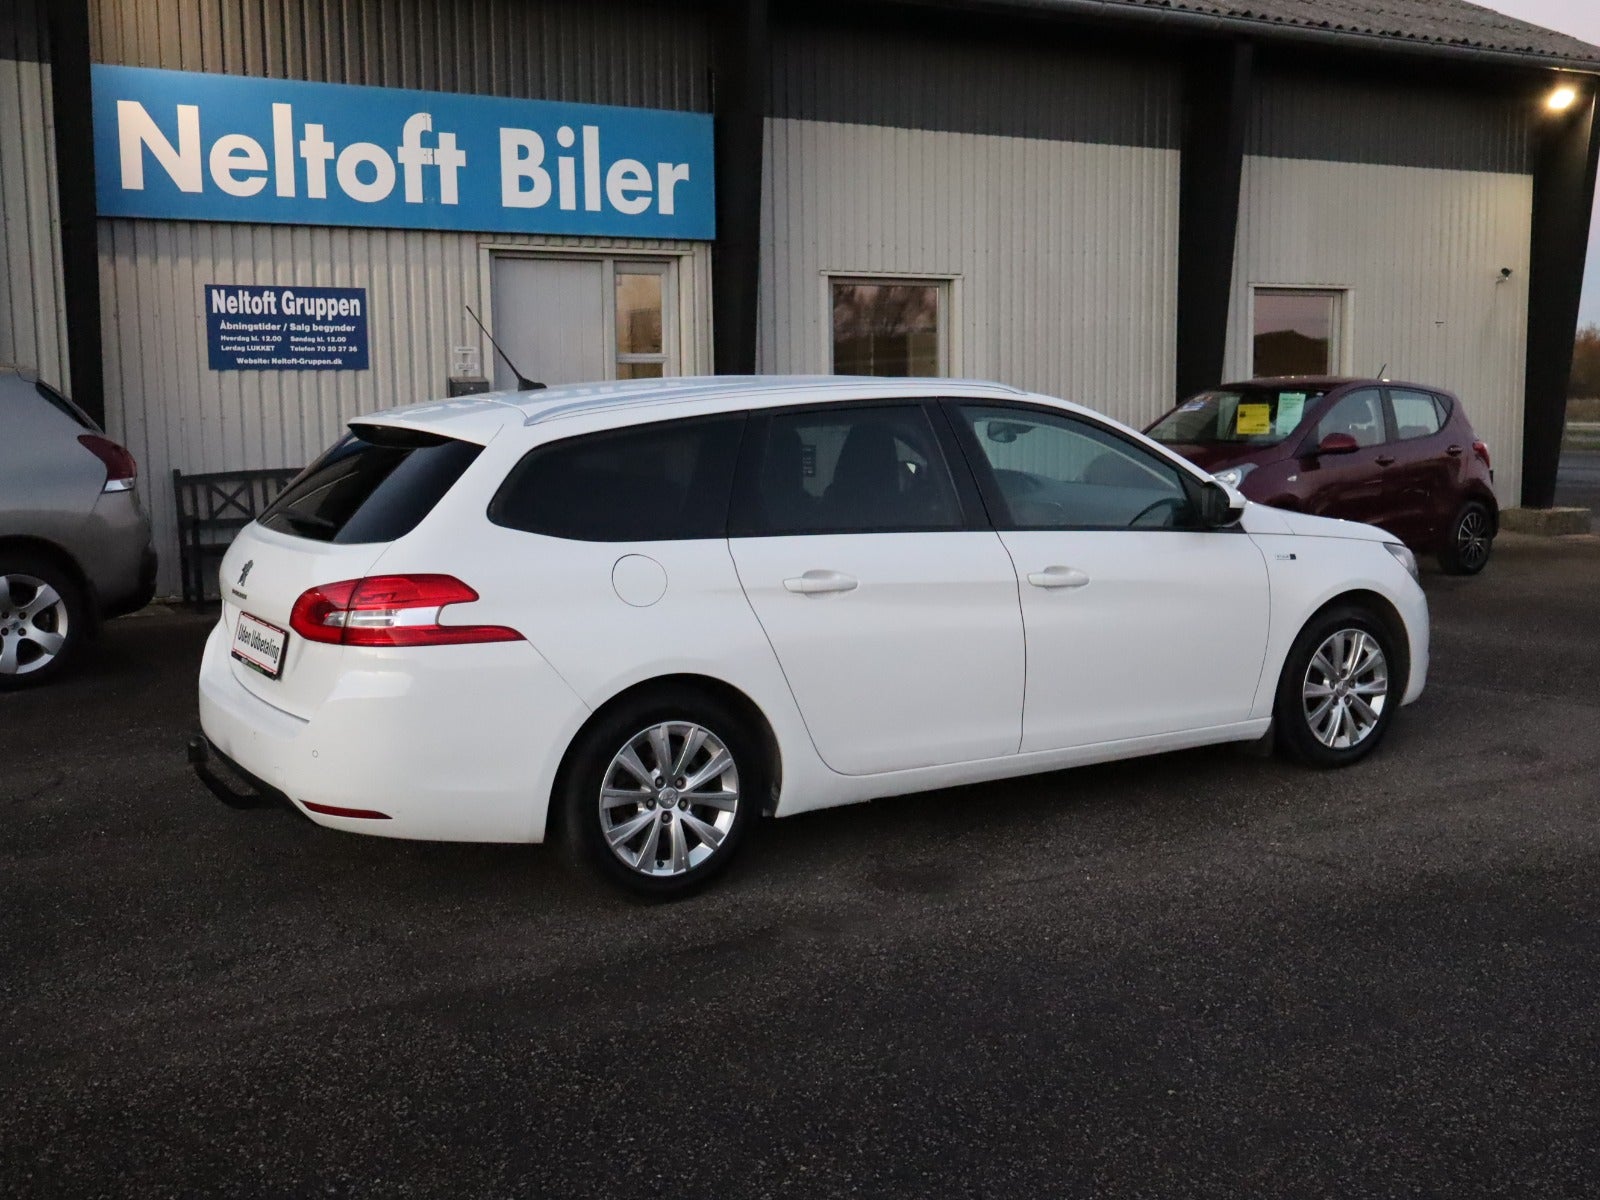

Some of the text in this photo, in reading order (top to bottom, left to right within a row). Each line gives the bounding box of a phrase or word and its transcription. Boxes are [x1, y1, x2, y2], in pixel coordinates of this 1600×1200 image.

[117, 100, 689, 215] Neltoft Biler
[212, 289, 360, 320] Neltoft Gruppen
[220, 320, 355, 332] Åbningstider / Salg begynder
[238, 624, 280, 663] Uden Udbetaling
